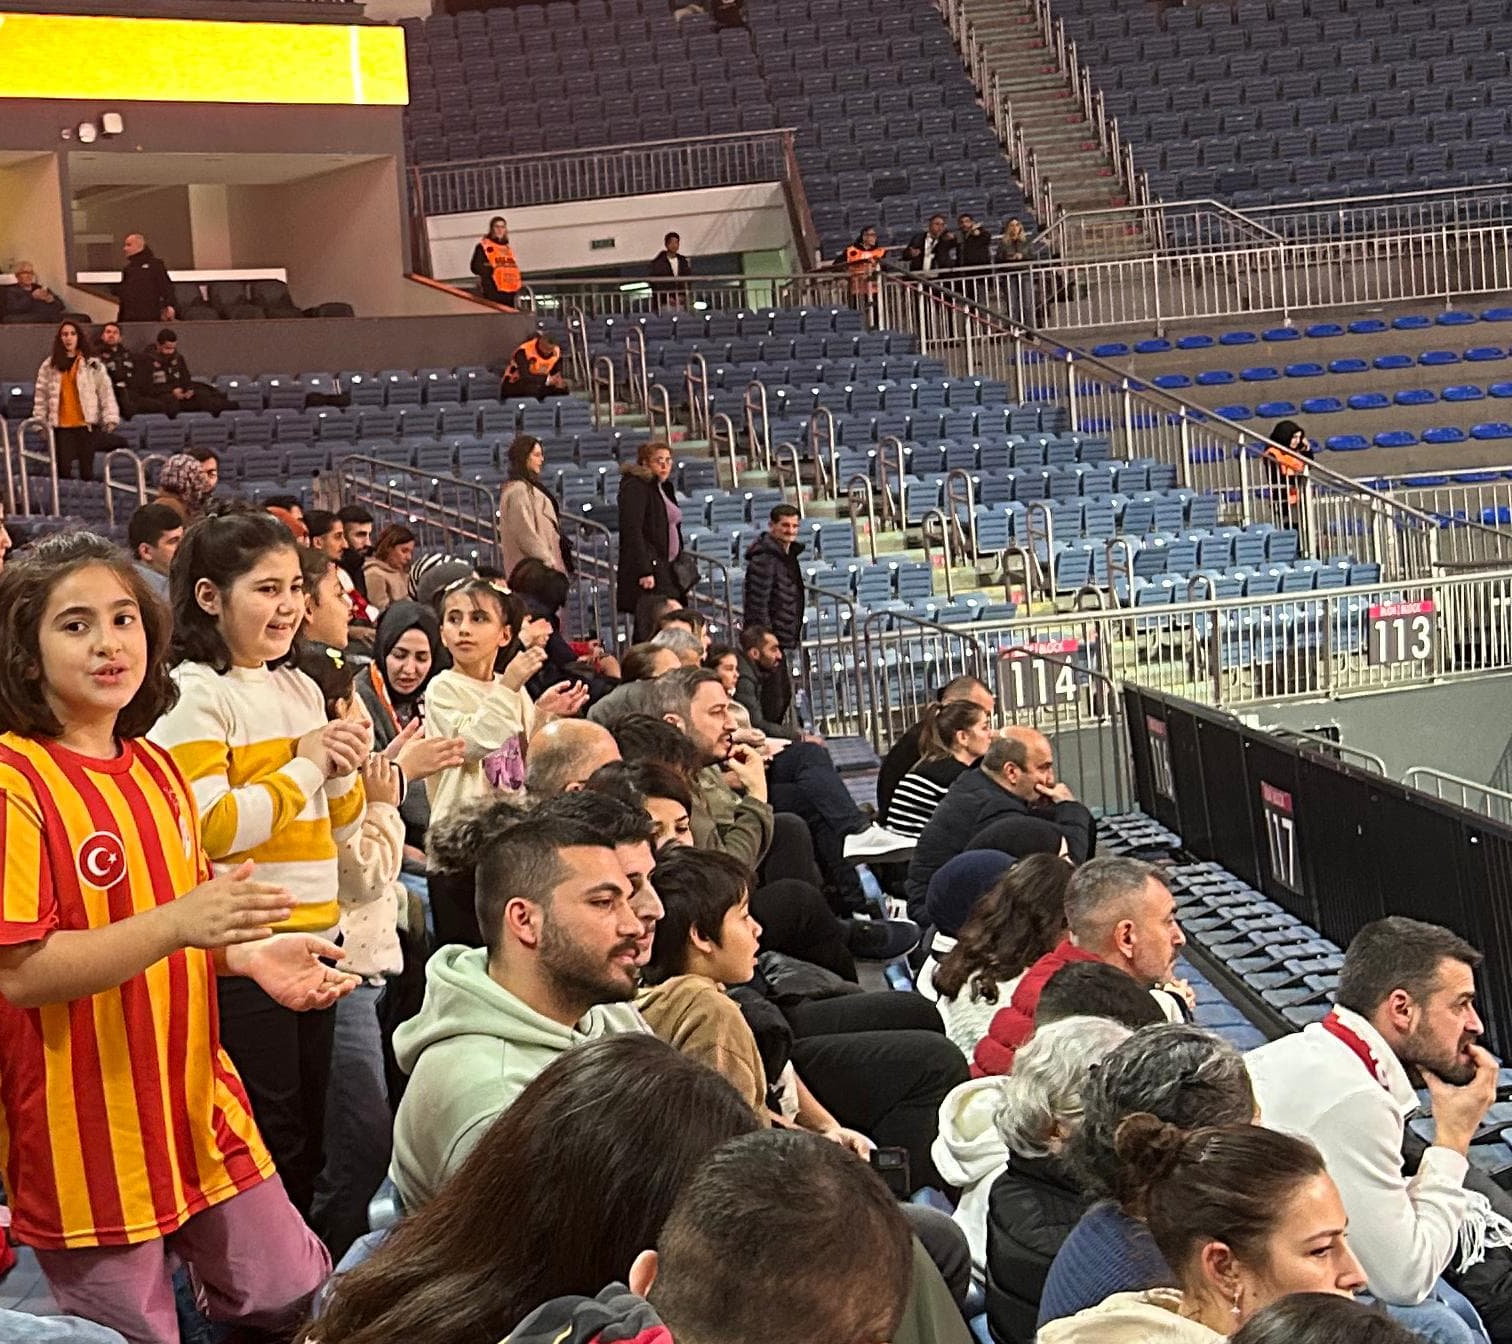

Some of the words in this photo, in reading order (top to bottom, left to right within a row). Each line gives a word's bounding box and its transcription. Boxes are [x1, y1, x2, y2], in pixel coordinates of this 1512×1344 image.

[1375, 616, 1431, 663] 113
[1011, 655, 1077, 708] 114
[1265, 807, 1294, 888] 117
